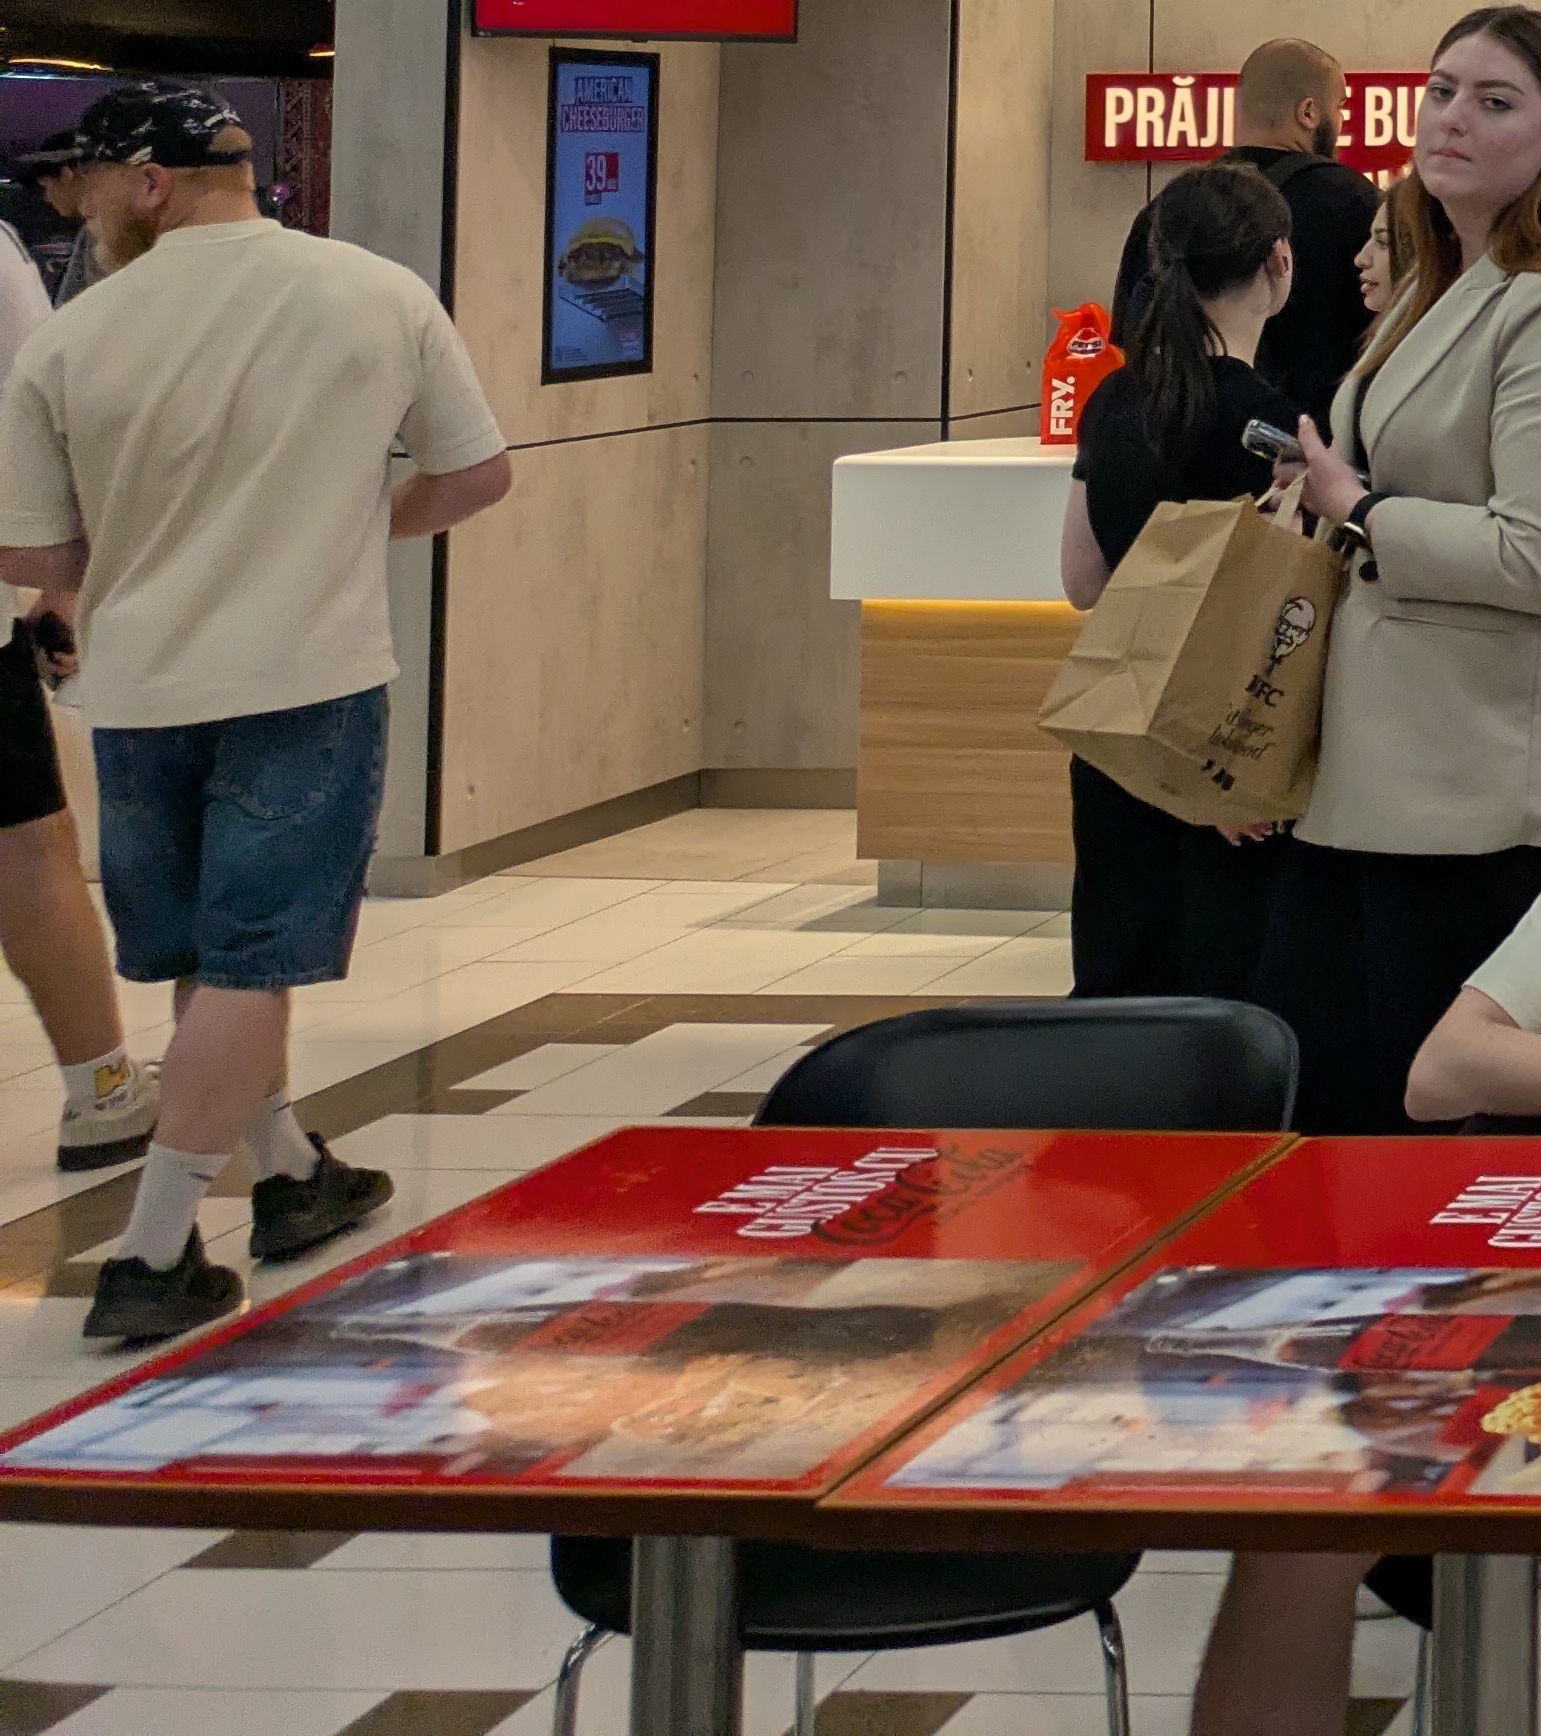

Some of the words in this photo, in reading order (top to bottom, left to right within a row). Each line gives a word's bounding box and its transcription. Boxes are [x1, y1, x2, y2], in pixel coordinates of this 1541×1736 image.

[576, 77, 633, 103] AMERICAN
[562, 105, 645, 132] CHEESEBURGER
[1104, 75, 1236, 148] PRĂJI
[586, 154, 606, 191] 39
[1050, 375, 1076, 435] FRY.
